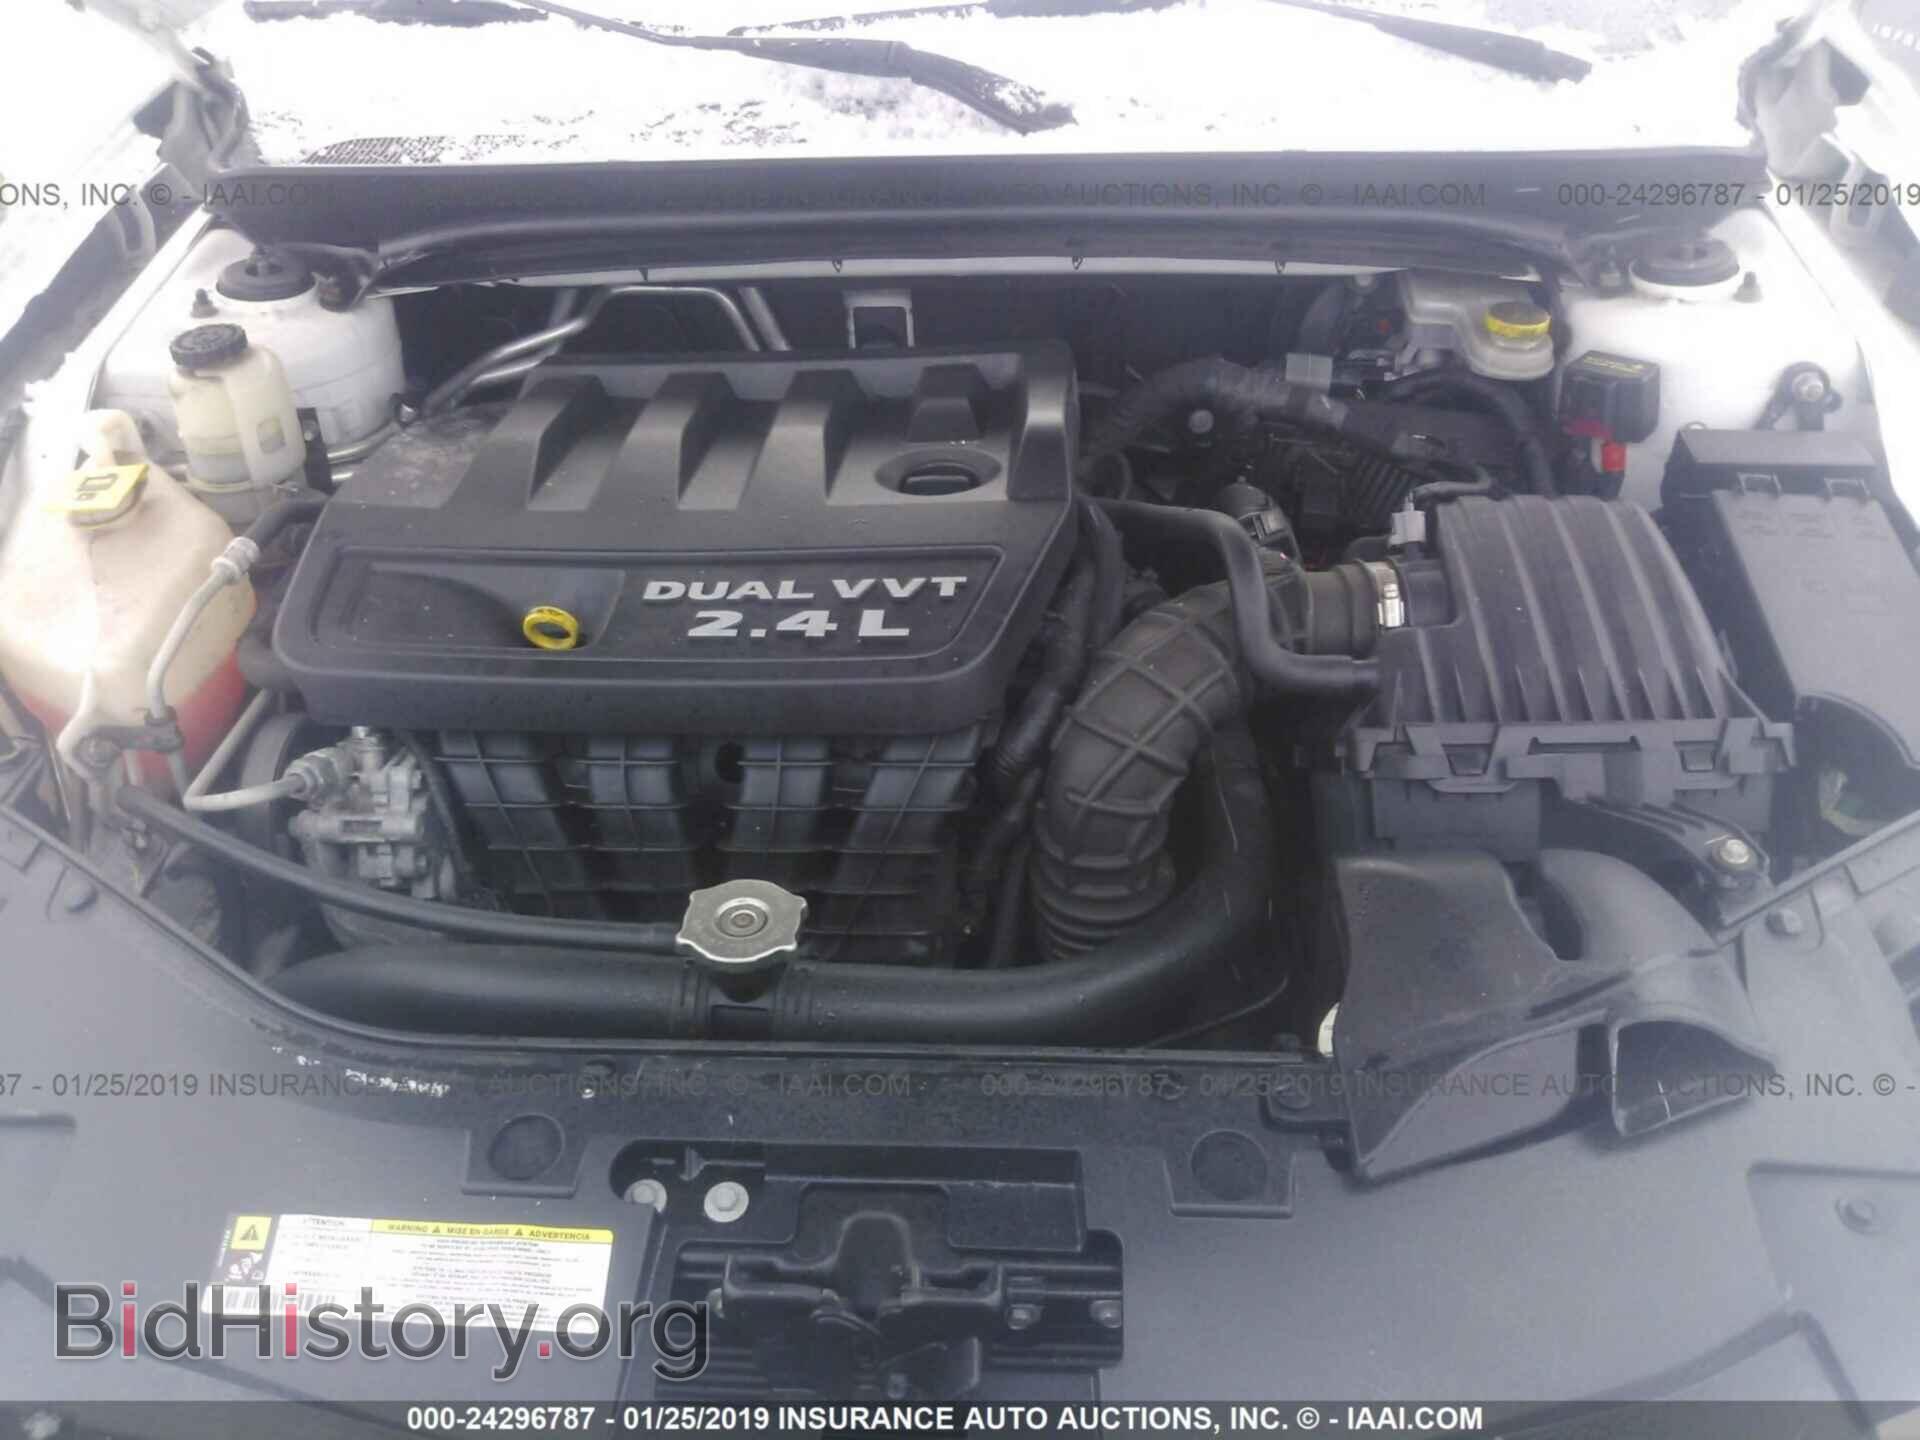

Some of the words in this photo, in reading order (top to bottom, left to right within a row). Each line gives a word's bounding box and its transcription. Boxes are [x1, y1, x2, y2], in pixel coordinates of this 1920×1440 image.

[643, 580, 814, 600] DUAL
[832, 576, 968, 598] VVT
[687, 609, 838, 638] 2.4
[858, 609, 910, 638] L
[528, 1229, 591, 1241] ADVERTENCIA
